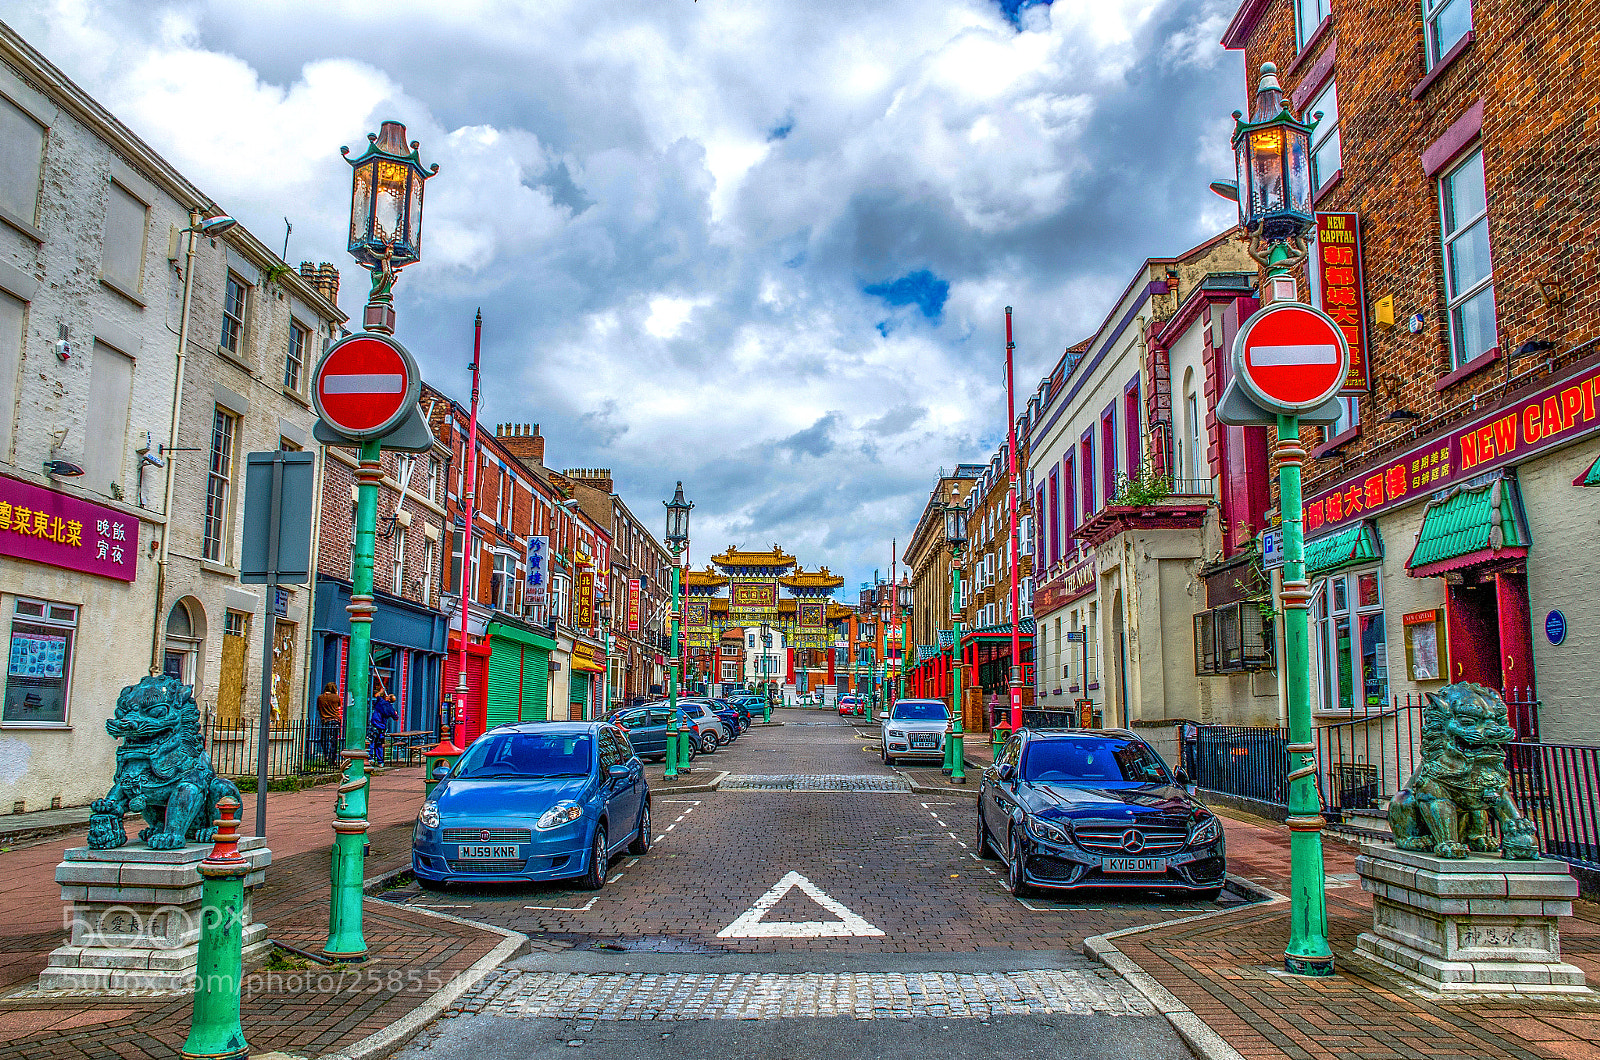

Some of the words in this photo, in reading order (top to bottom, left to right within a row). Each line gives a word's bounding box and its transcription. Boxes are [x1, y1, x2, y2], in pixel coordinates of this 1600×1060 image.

[1327, 216, 1346, 229] NEW
[1320, 230, 1355, 243] CAPITAL
[1460, 412, 1518, 471] NEW
[1302, 463, 1407, 534] 都城大酒樓
[96, 518, 126, 541] 晚飯
[1064, 571, 1077, 595] THE
[1077, 561, 1095, 588] NOOK
[462, 847, 491, 858] MJ59
[493, 846, 516, 858] KNR
[1109, 859, 1136, 870] KY15
[1138, 859, 1160, 871] OMT
